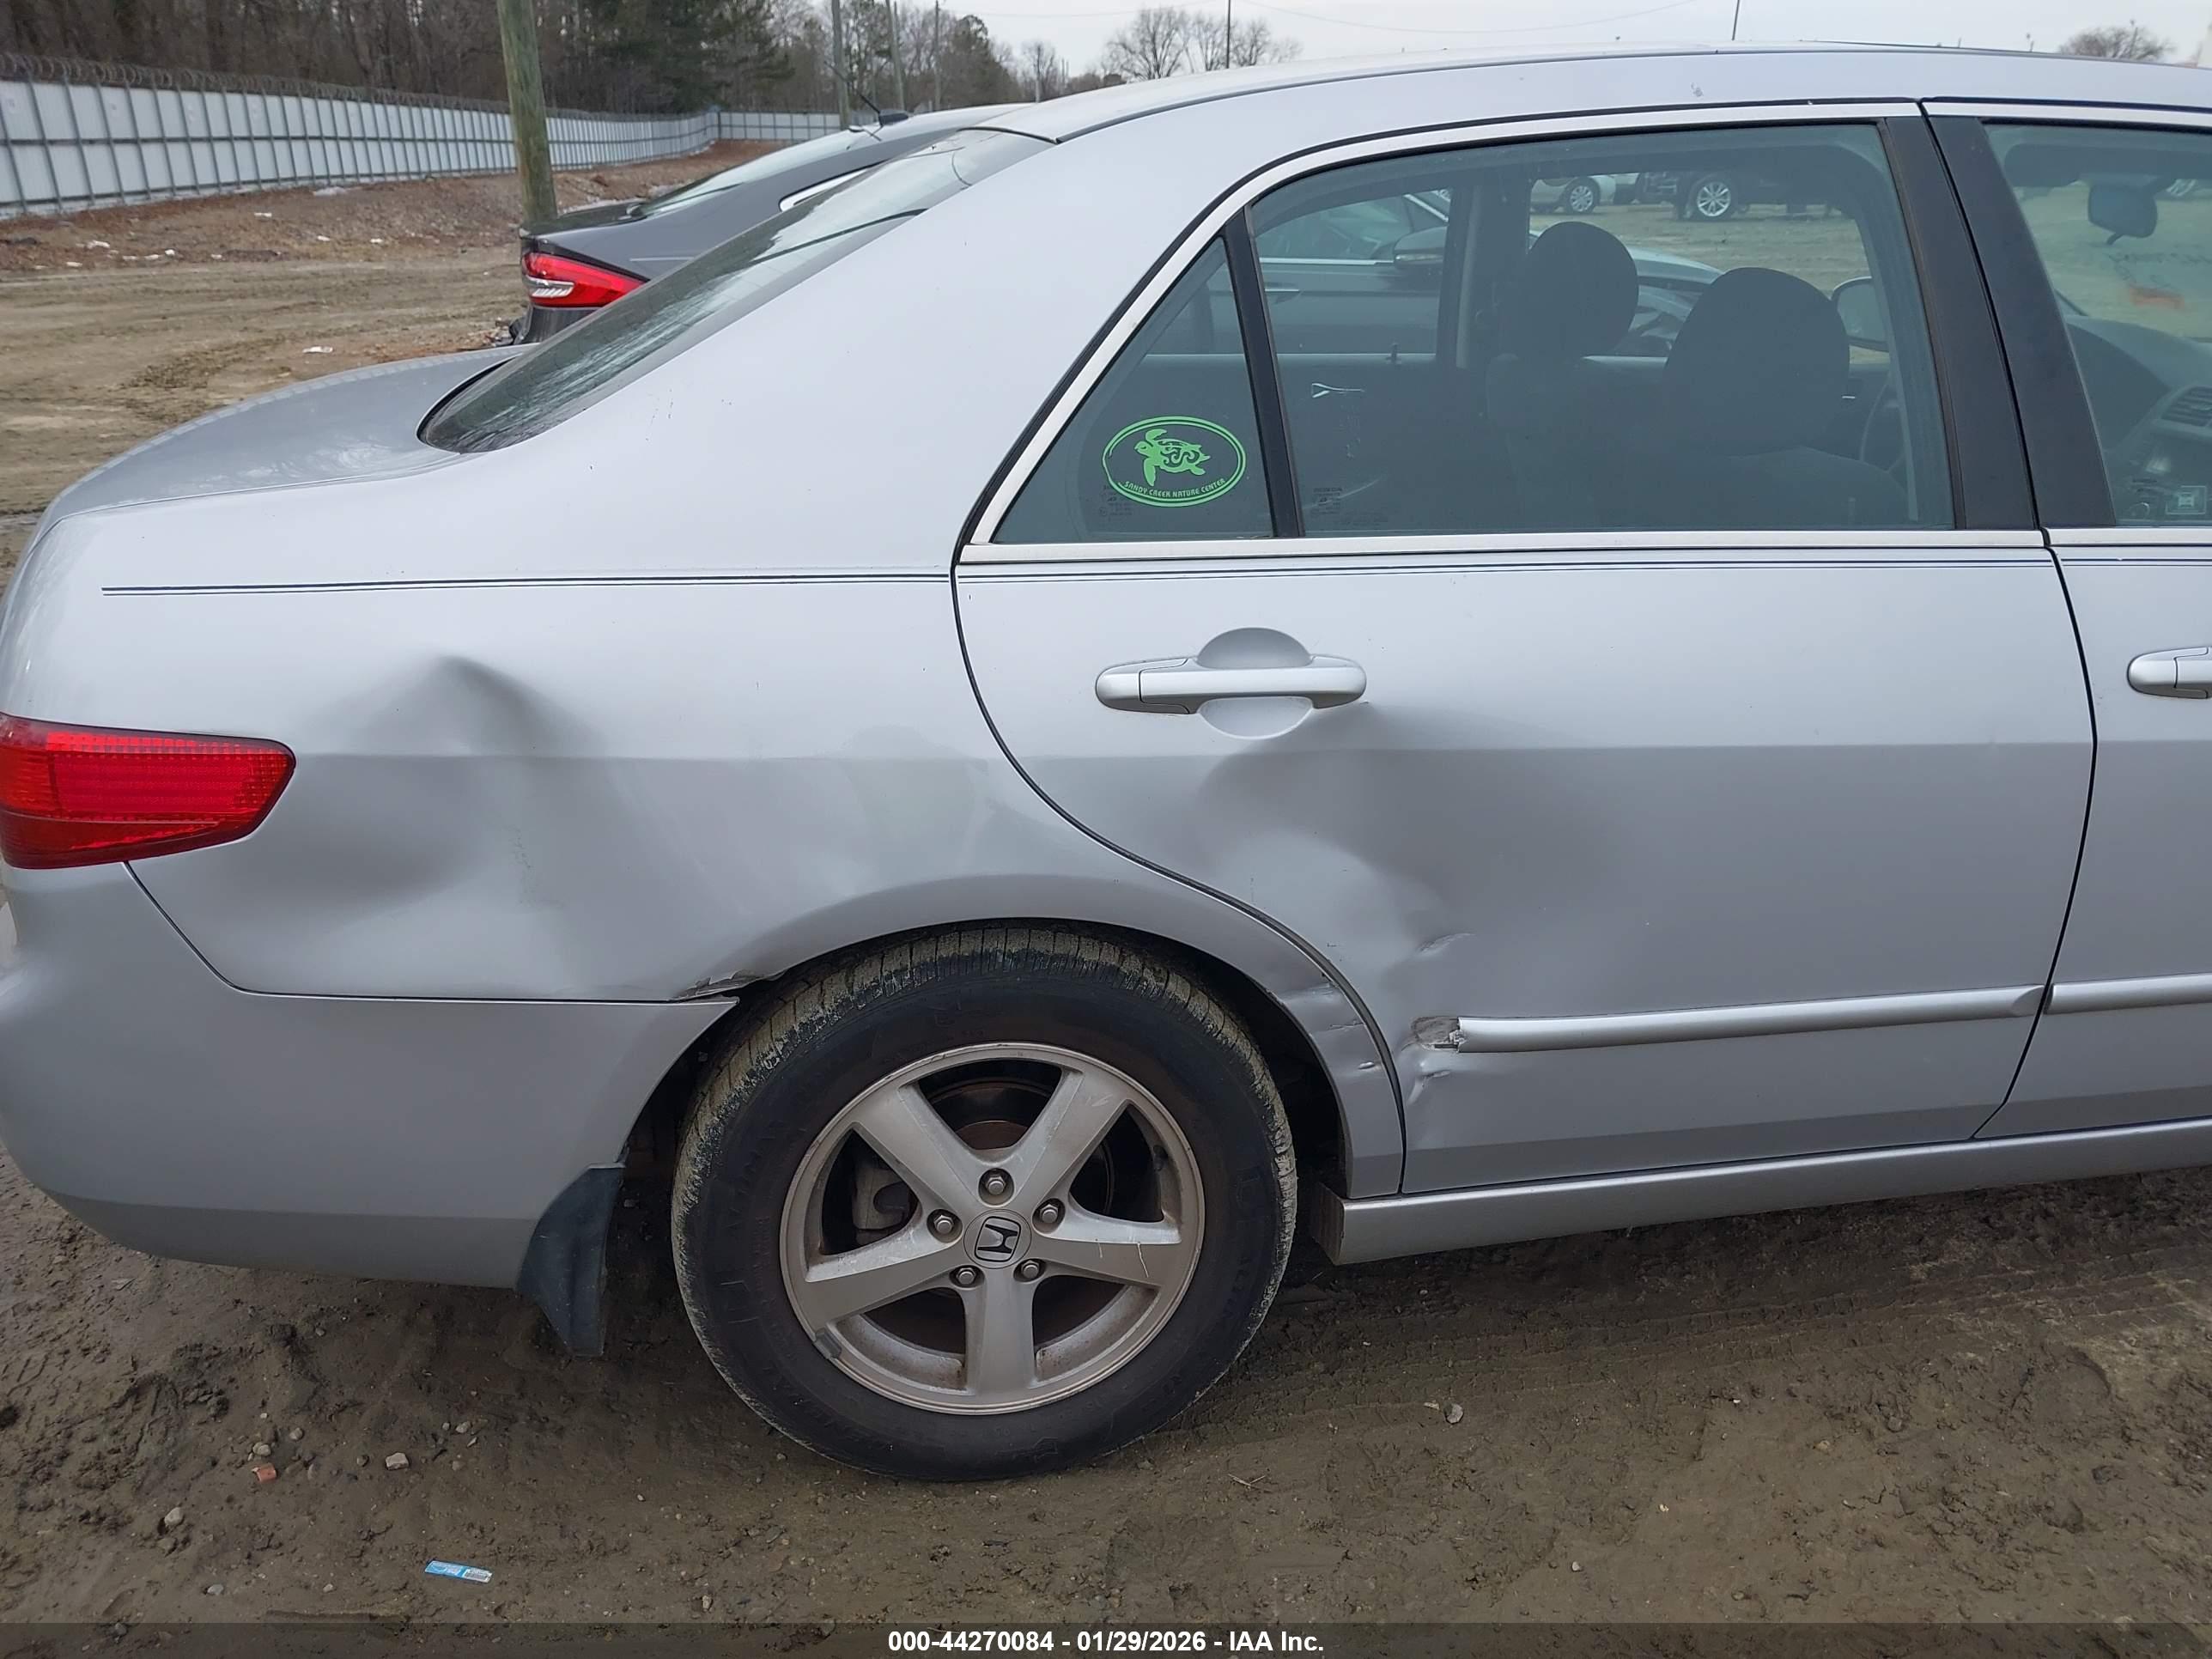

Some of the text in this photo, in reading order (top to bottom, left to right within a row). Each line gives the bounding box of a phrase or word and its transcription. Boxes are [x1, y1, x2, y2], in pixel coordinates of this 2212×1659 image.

[1124, 478, 1226, 498] SANDY CREEK NATURE CENTER
